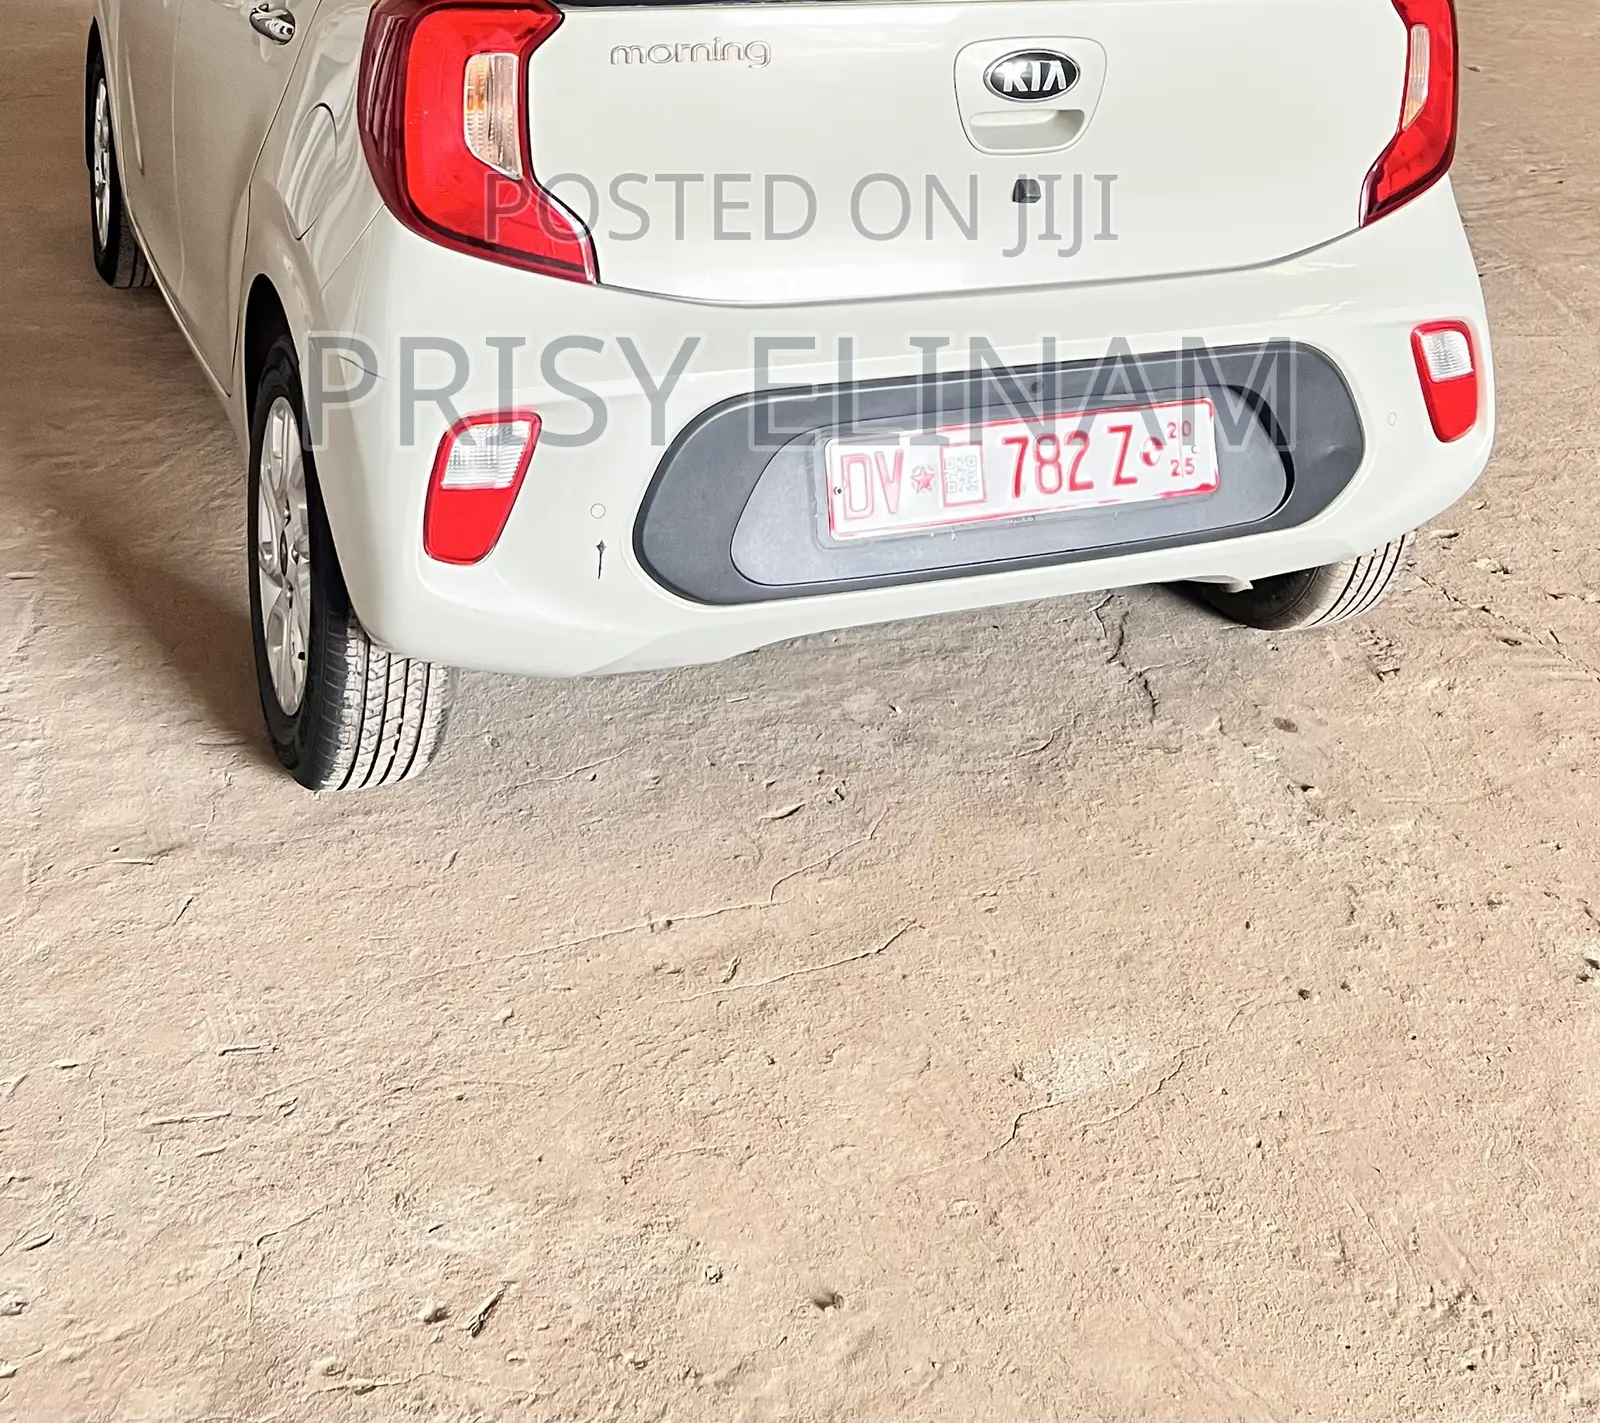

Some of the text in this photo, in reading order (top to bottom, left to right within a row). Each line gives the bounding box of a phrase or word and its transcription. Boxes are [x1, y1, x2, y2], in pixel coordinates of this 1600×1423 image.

[610, 36, 771, 69] morning
[1002, 59, 1067, 92] KIA
[1167, 419, 1192, 439] 20
[840, 423, 1139, 520] DV 782 Z
[1170, 457, 1196, 477] 25
